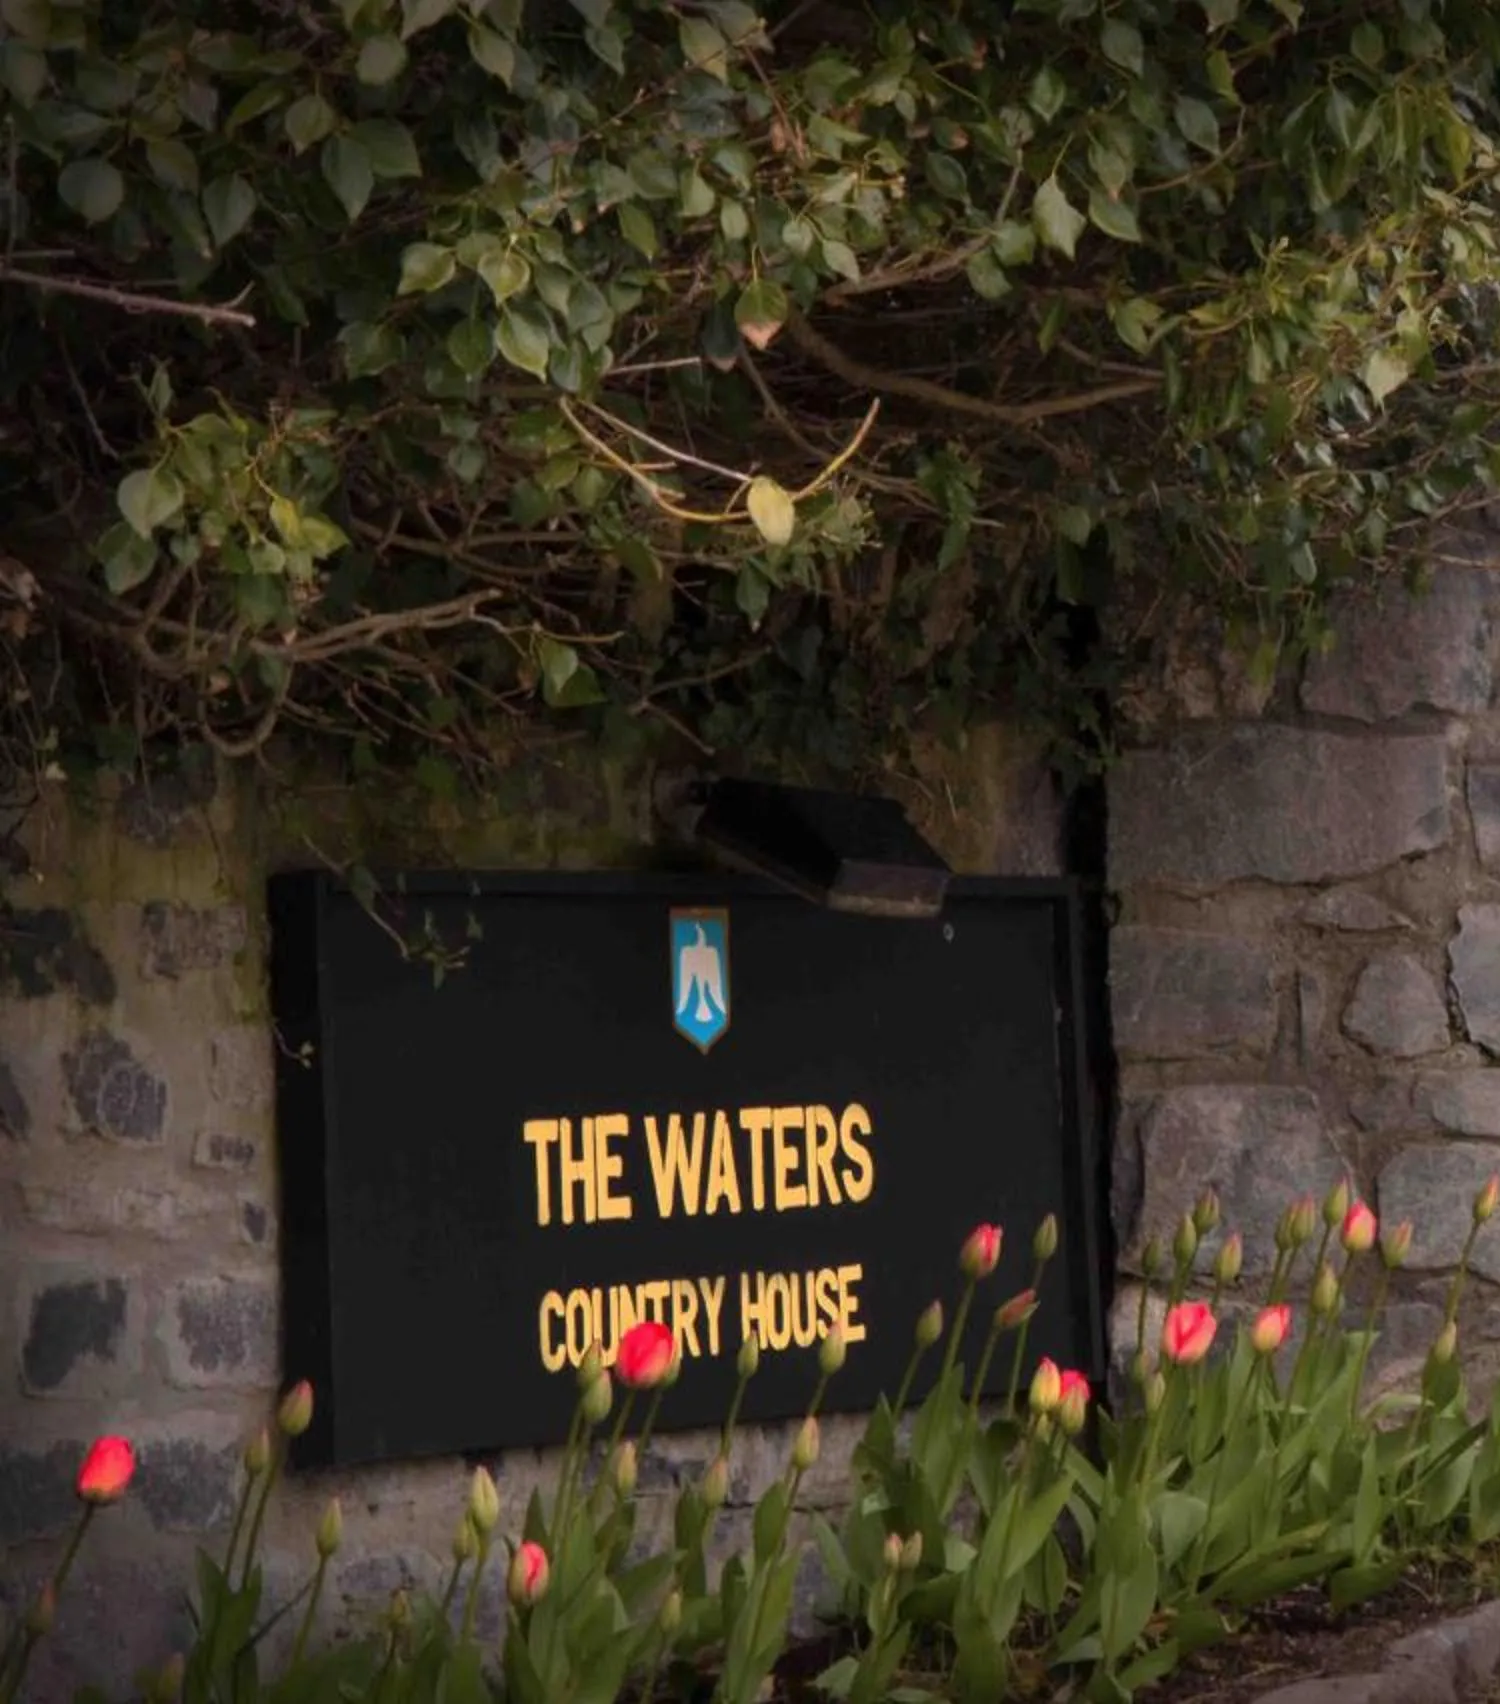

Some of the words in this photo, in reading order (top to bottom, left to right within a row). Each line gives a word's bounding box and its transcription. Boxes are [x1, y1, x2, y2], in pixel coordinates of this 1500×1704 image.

[523, 1113, 632, 1227] THE
[643, 1102, 876, 1218] WATERS
[739, 1263, 867, 1351] HOUSE
